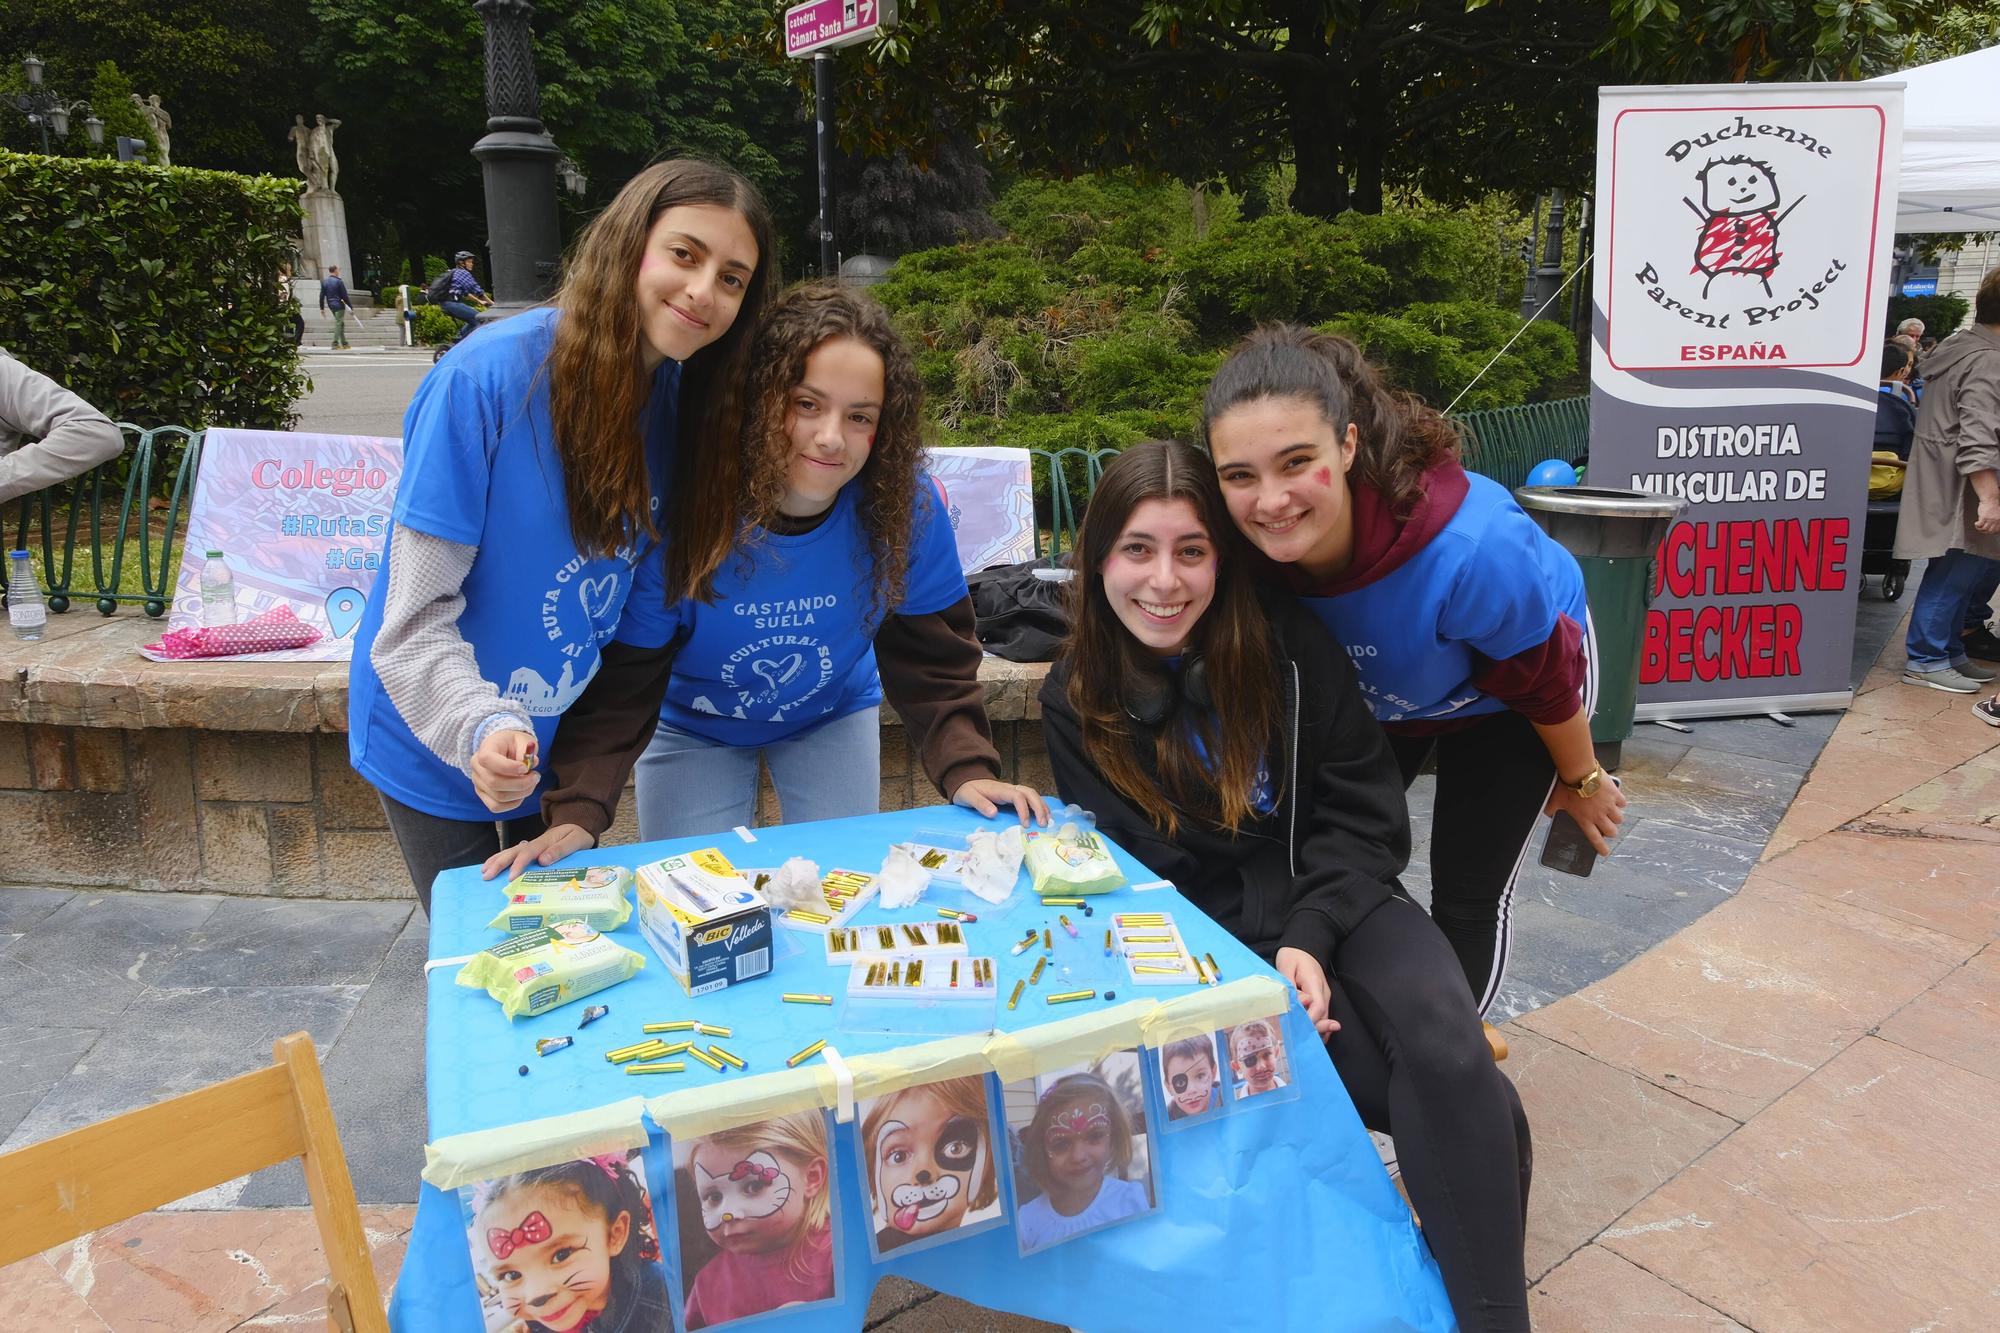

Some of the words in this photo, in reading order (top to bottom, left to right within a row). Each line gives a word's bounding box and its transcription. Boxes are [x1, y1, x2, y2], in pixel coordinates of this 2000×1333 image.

[789, 9, 816, 28] catedral
[820, 20, 842, 38] Santa
[1665, 116, 1832, 162] Duchenne
[1635, 261, 1730, 329] Parent
[1743, 258, 1847, 326] Project
[1680, 341, 1787, 361] ESPAÑA
[1656, 424, 1802, 458] DISTROFIA
[251, 459, 387, 497] Colegio
[1631, 470, 1778, 503] MUSCULAR
[1784, 469, 1827, 500] DE
[542, 588, 562, 641] RUTA
[734, 595, 837, 616] GASTANDO
[754, 613, 815, 629] SUELA
[729, 635, 819, 662] CULTURAL
[1638, 603, 1802, 684] BECKER
[724, 919, 763, 951] Velleda
[697, 984, 713, 993] 1701
[715, 980, 723, 988] 09
